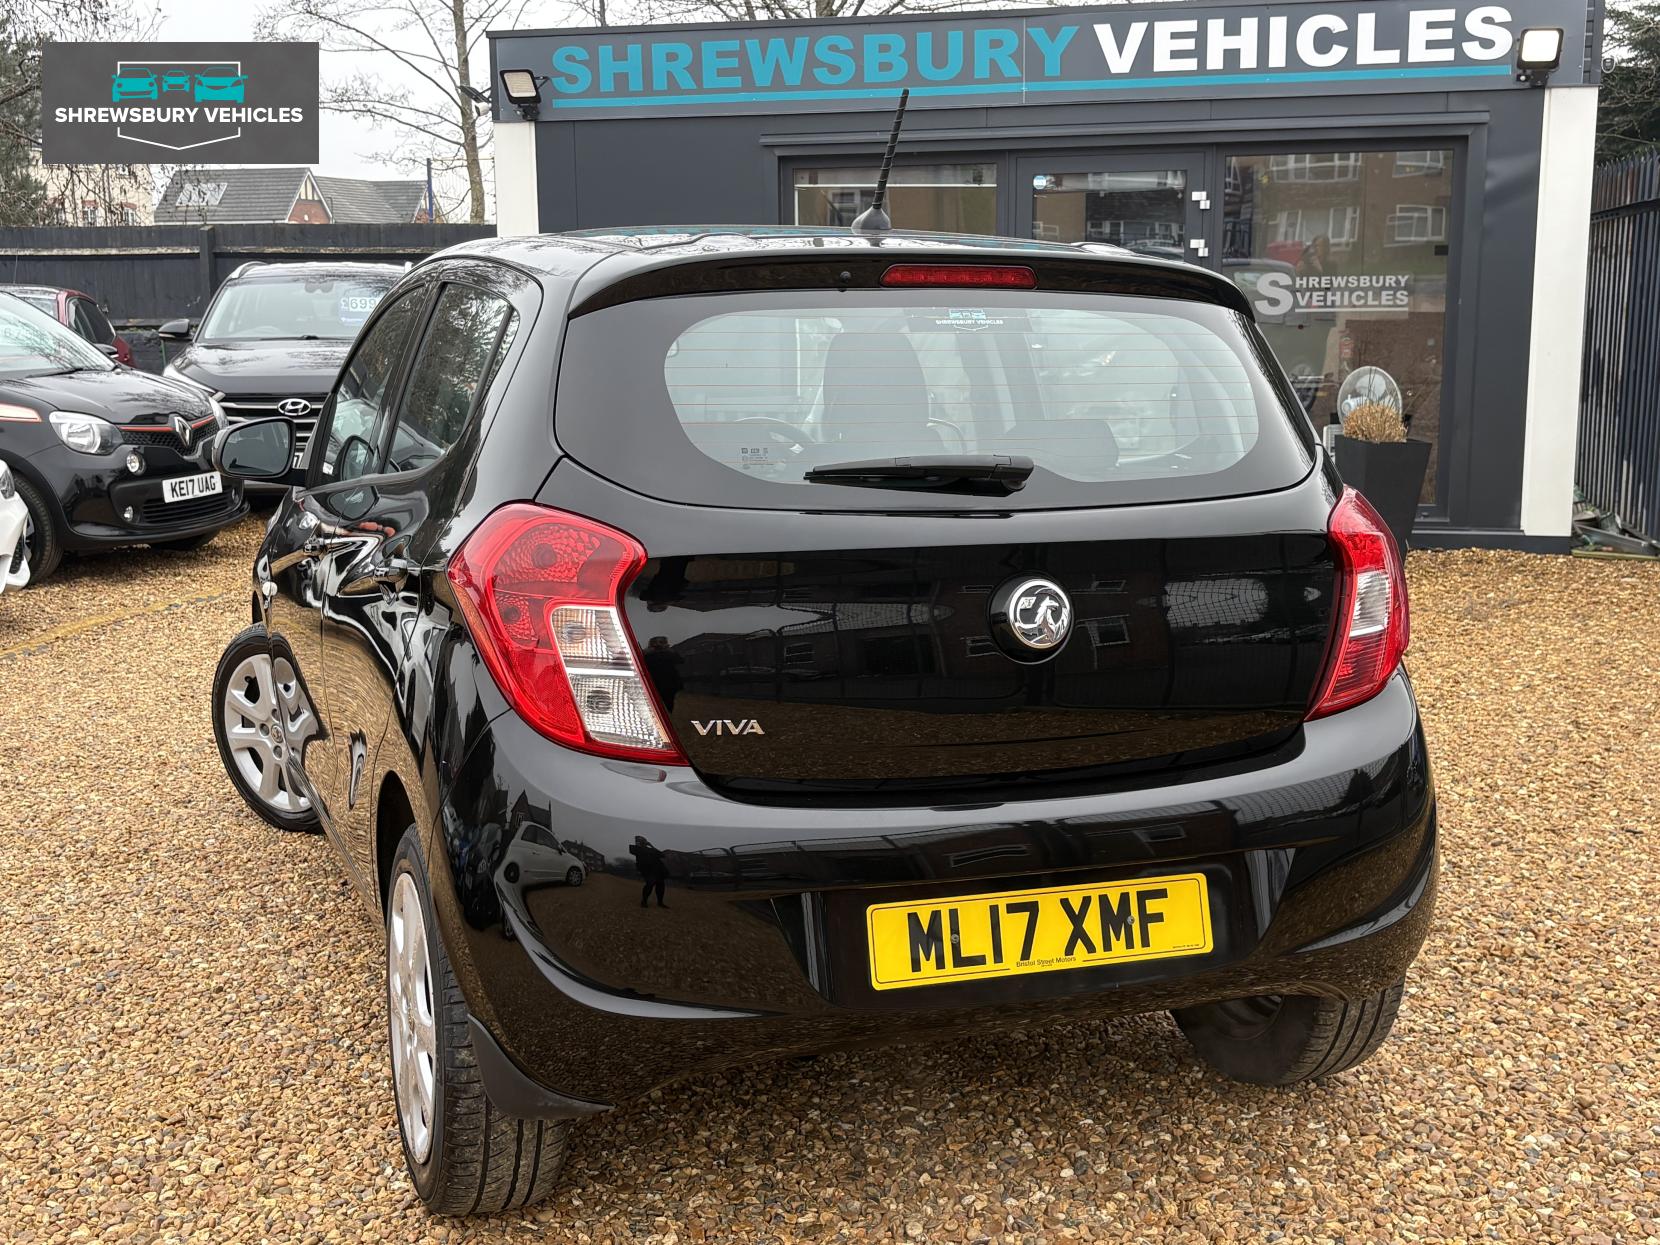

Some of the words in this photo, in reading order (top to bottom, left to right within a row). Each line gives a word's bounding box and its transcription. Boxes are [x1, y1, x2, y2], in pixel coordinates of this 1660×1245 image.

[551, 25, 1080, 94] SHREWSBURY
[1093, 6, 1513, 74] VEHICLES
[1295, 290, 1409, 306] VEHICLES
[170, 478, 195, 498] KE17
[197, 475, 216, 494] UAG
[690, 719, 766, 736] VIVA
[907, 900, 1040, 973] ML17
[1059, 888, 1169, 957] XMF
[1037, 957, 1055, 965] Street
